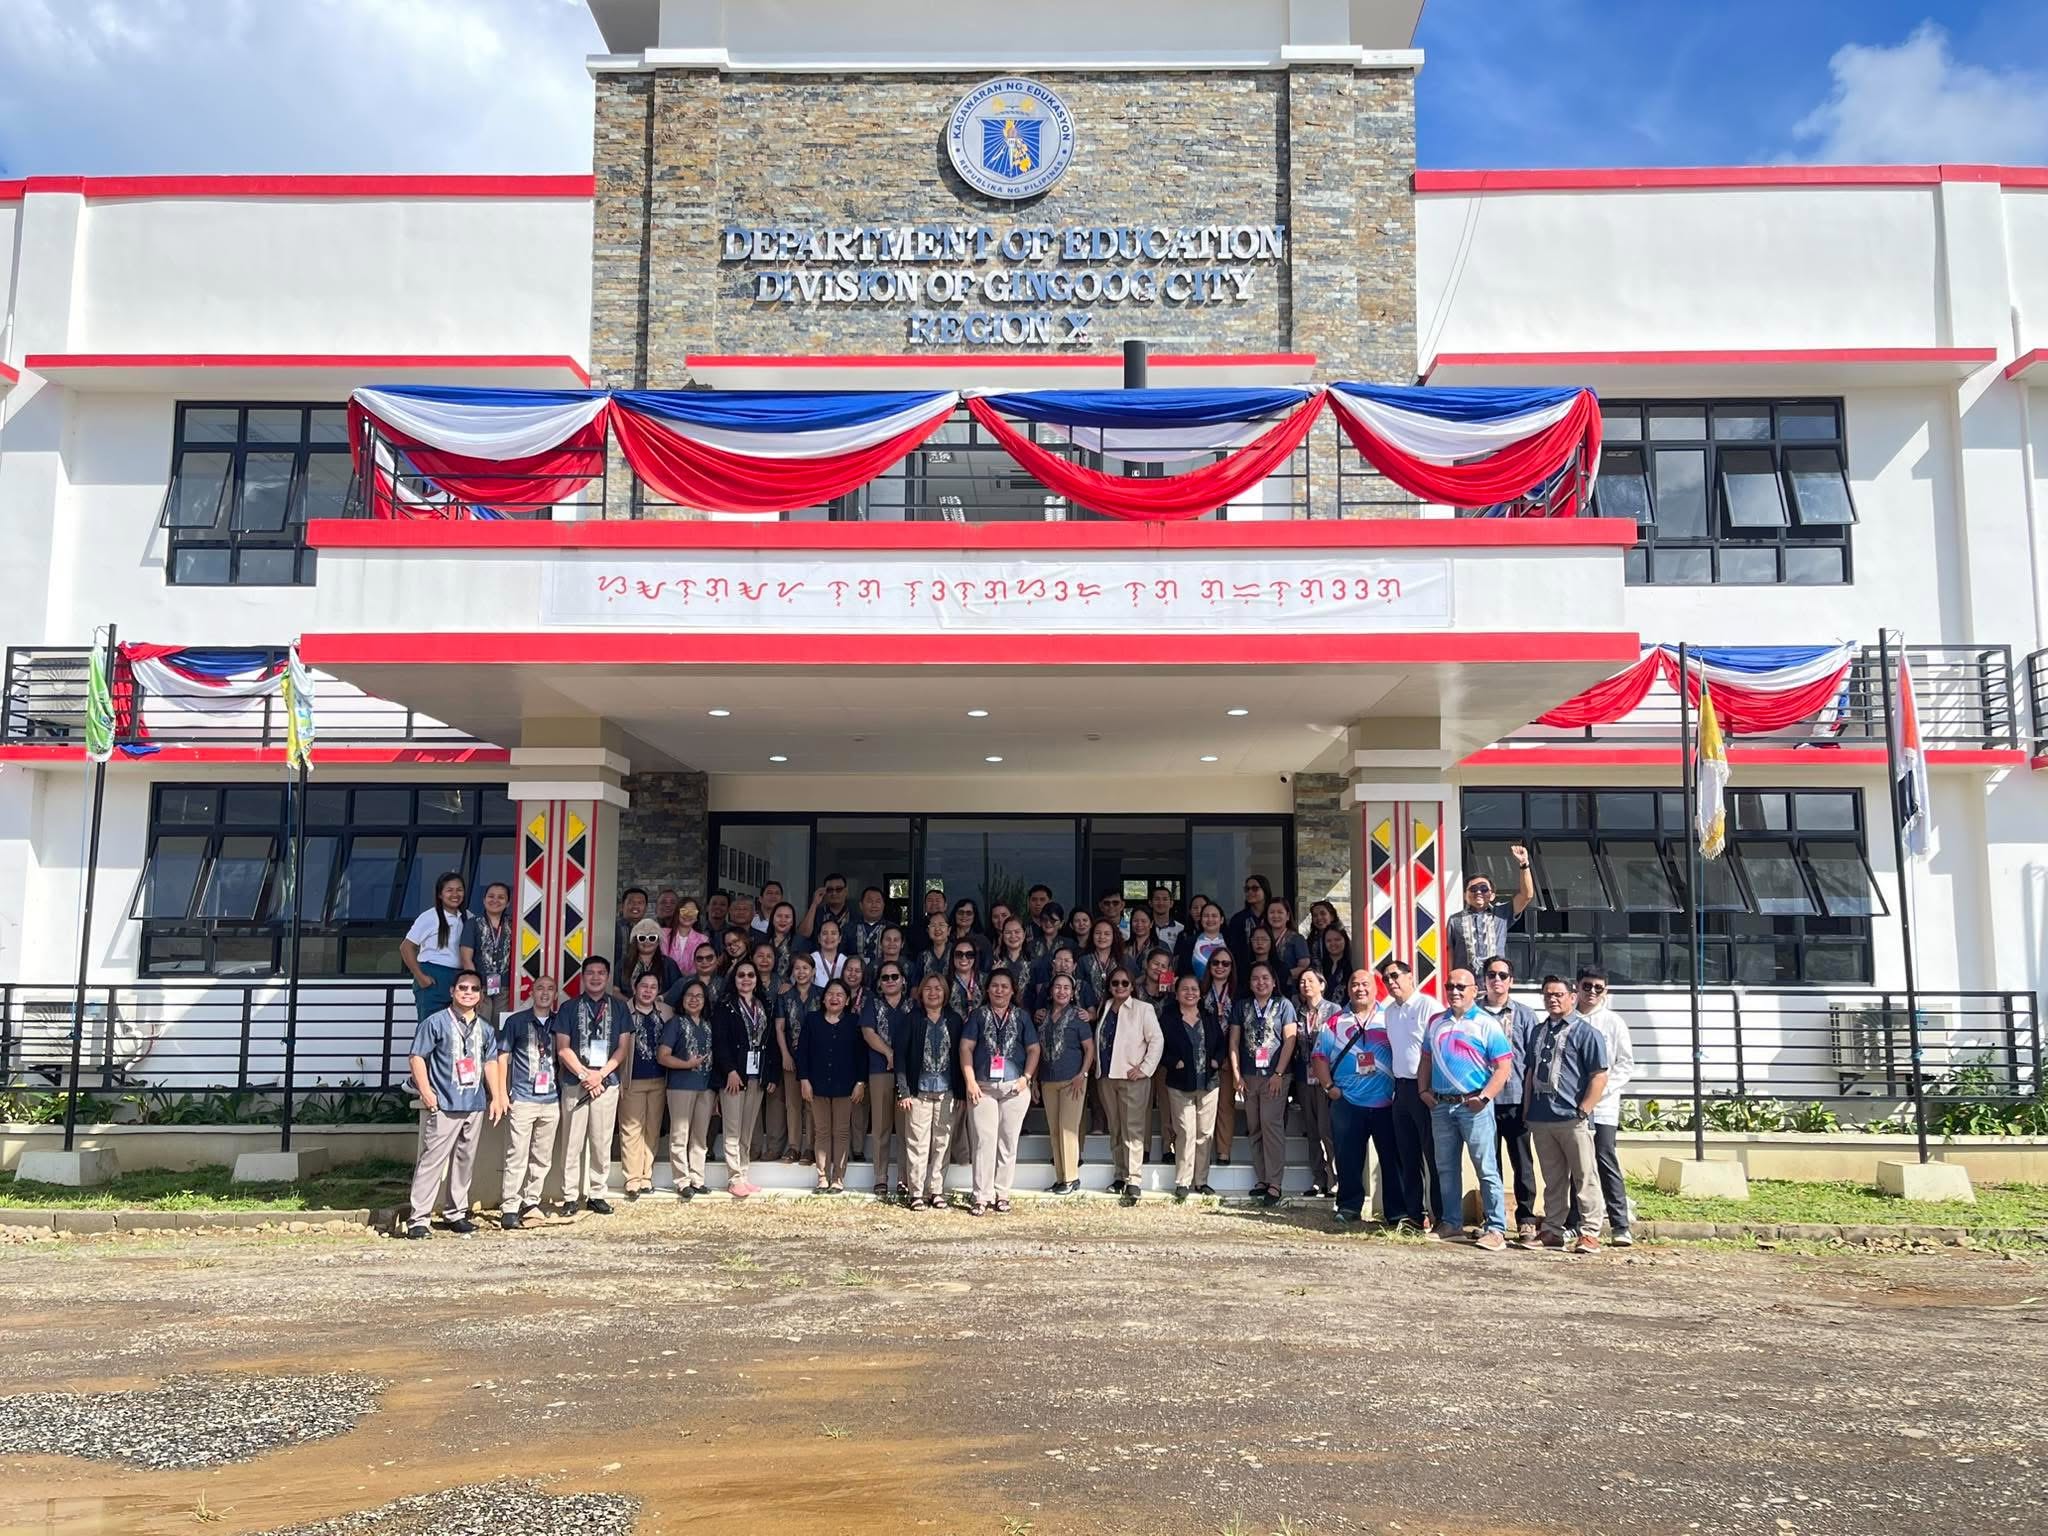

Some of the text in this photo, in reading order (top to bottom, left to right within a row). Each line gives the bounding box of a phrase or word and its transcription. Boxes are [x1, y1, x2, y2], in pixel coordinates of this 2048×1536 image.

[953, 82, 1070, 141] KAGAWARAN NG EDUKASYON
[959, 159, 1003, 193] REPUBLIKA
[1024, 161, 1063, 191] PILIPINAS
[722, 225, 1286, 260] DEPARTMENT OF EDUCATION
[756, 268, 1255, 302] DIVISION OF GINGOOG CITY
[908, 311, 1093, 344] REGION X
